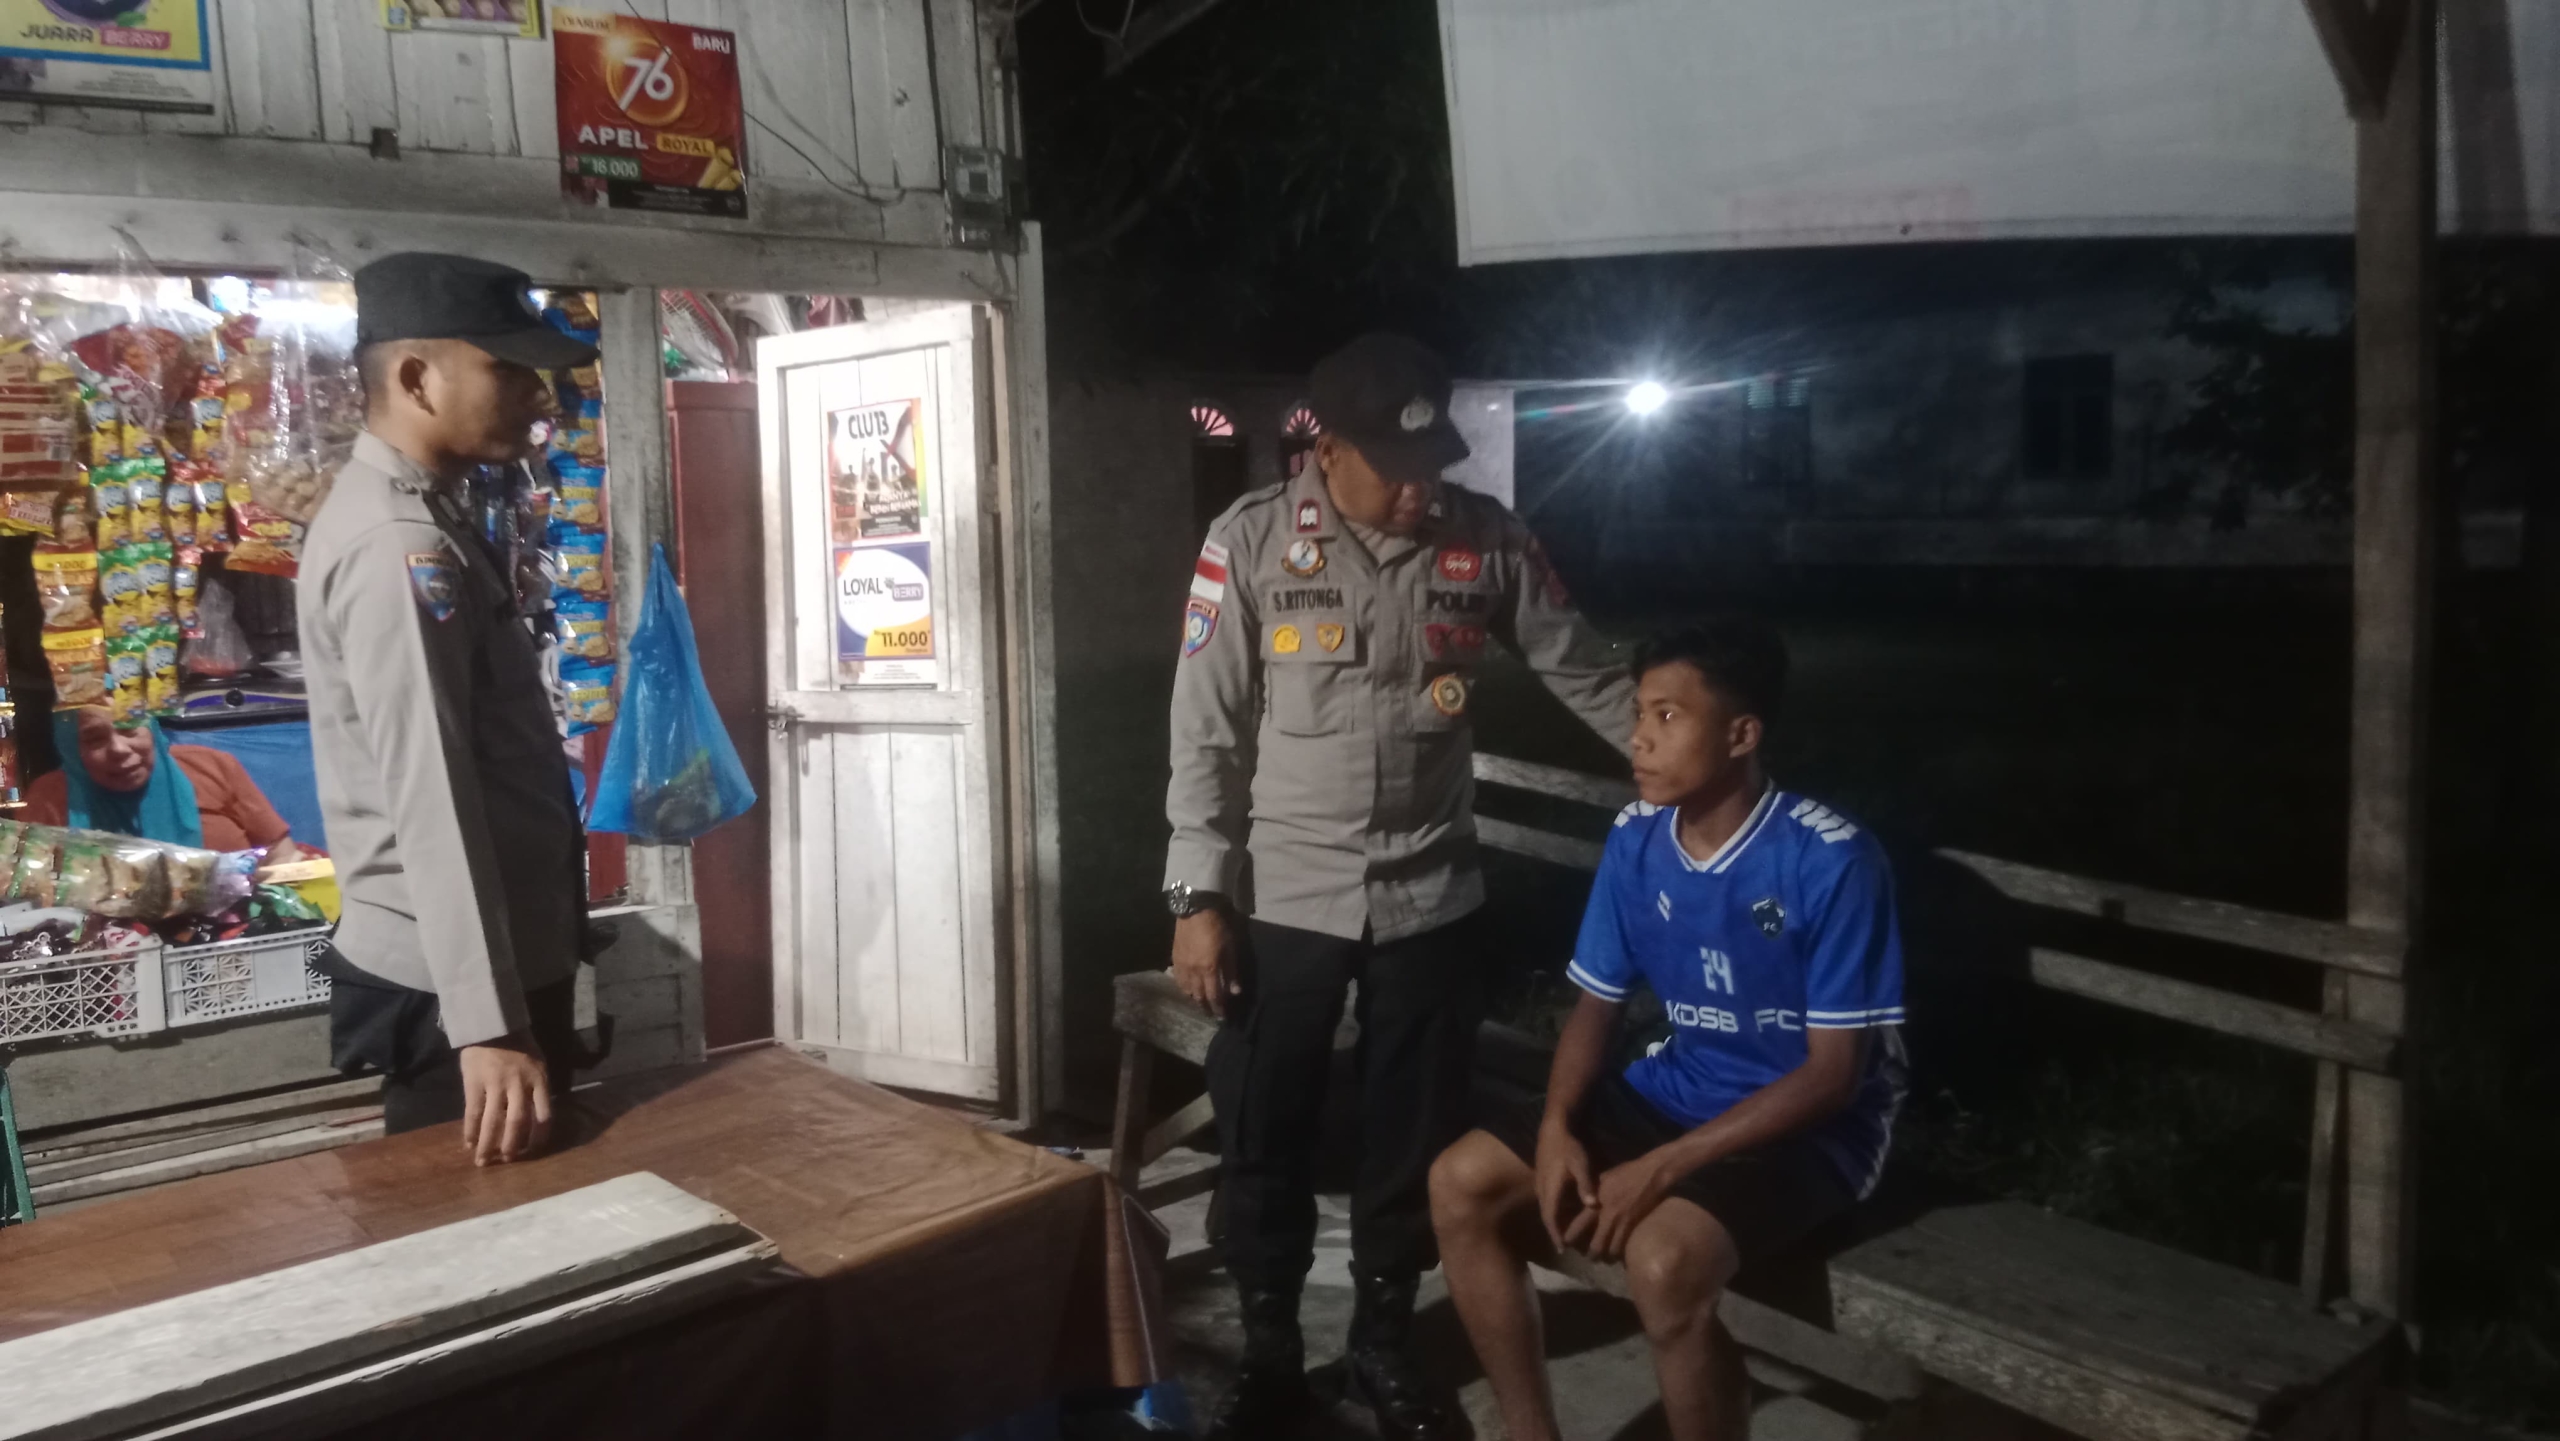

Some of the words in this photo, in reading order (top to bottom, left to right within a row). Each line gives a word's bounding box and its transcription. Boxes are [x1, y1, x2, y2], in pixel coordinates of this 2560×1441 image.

[19, 24, 94, 43] JUARA
[105, 29, 165, 47] BERRY
[692, 32, 730, 54] BARU
[619, 46, 674, 112] 76
[578, 124, 649, 149] APEL
[662, 135, 713, 154] ROYAL
[843, 577, 883, 596] LOYAL
[893, 584, 921, 599] BERRY
[1273, 586, 1343, 613] S.RITONGA
[1426, 589, 1487, 613] POL
[881, 631, 928, 647] 11.000
[1755, 1008, 1801, 1033] FC
